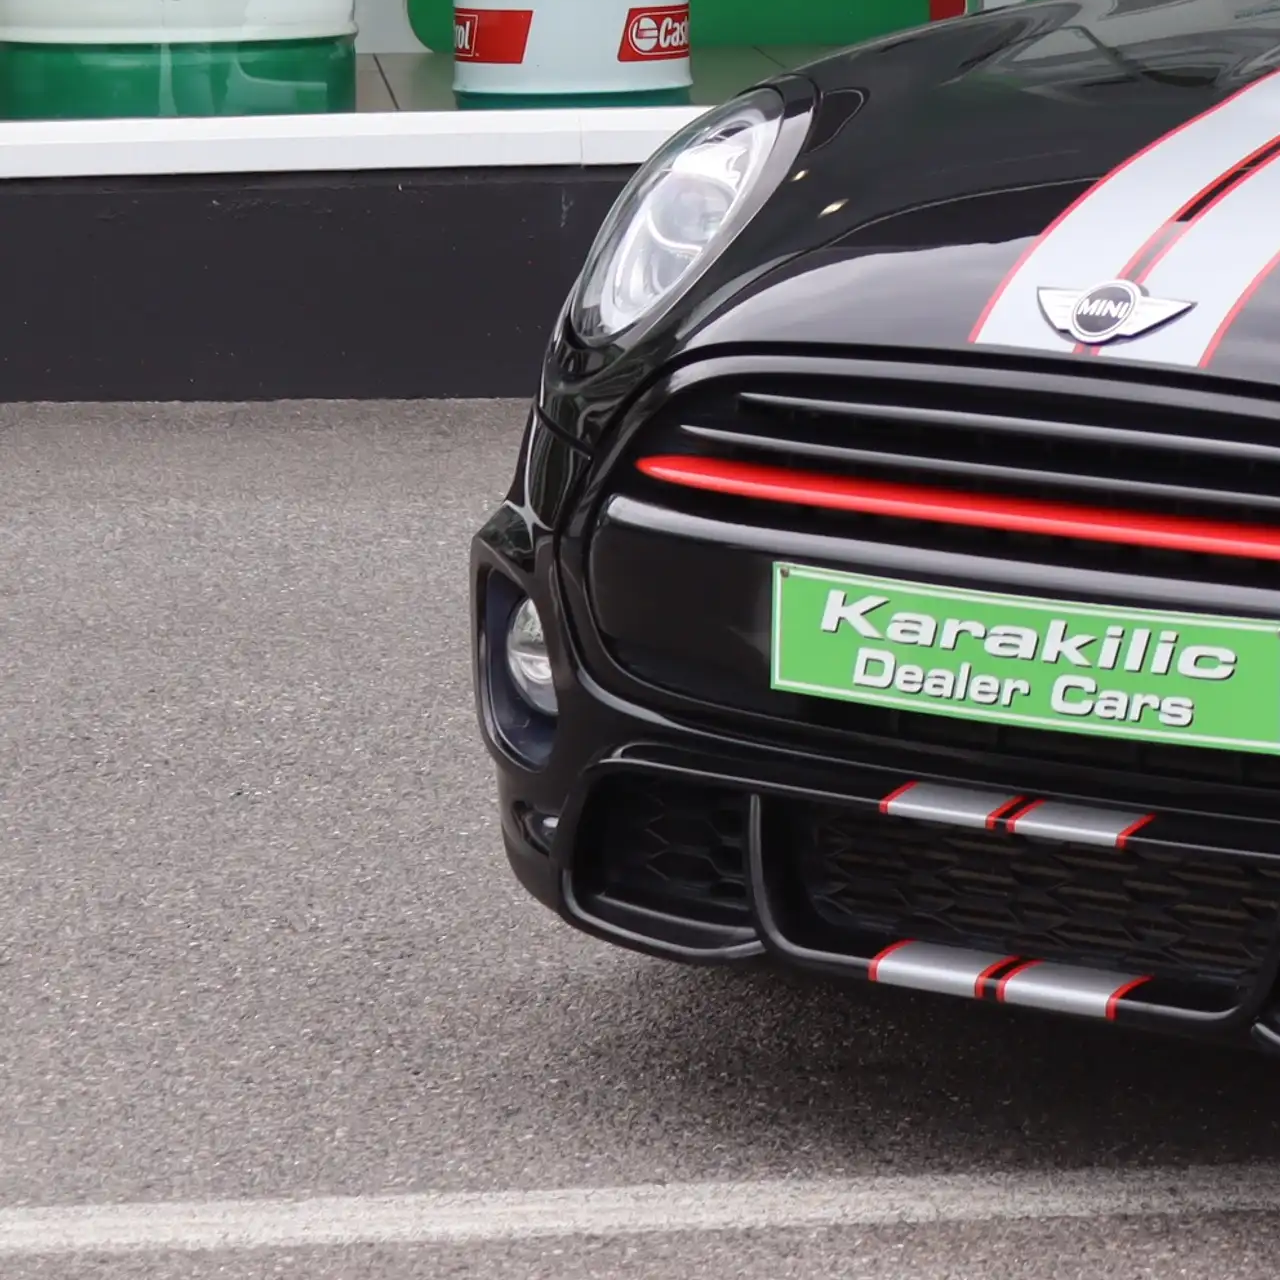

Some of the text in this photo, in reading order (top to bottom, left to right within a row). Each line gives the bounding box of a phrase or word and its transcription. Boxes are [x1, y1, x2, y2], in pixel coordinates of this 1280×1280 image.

[1077, 298, 1130, 319] MINI
[819, 588, 1239, 682] Karakilic
[851, 647, 1195, 728] Dealer Cars
